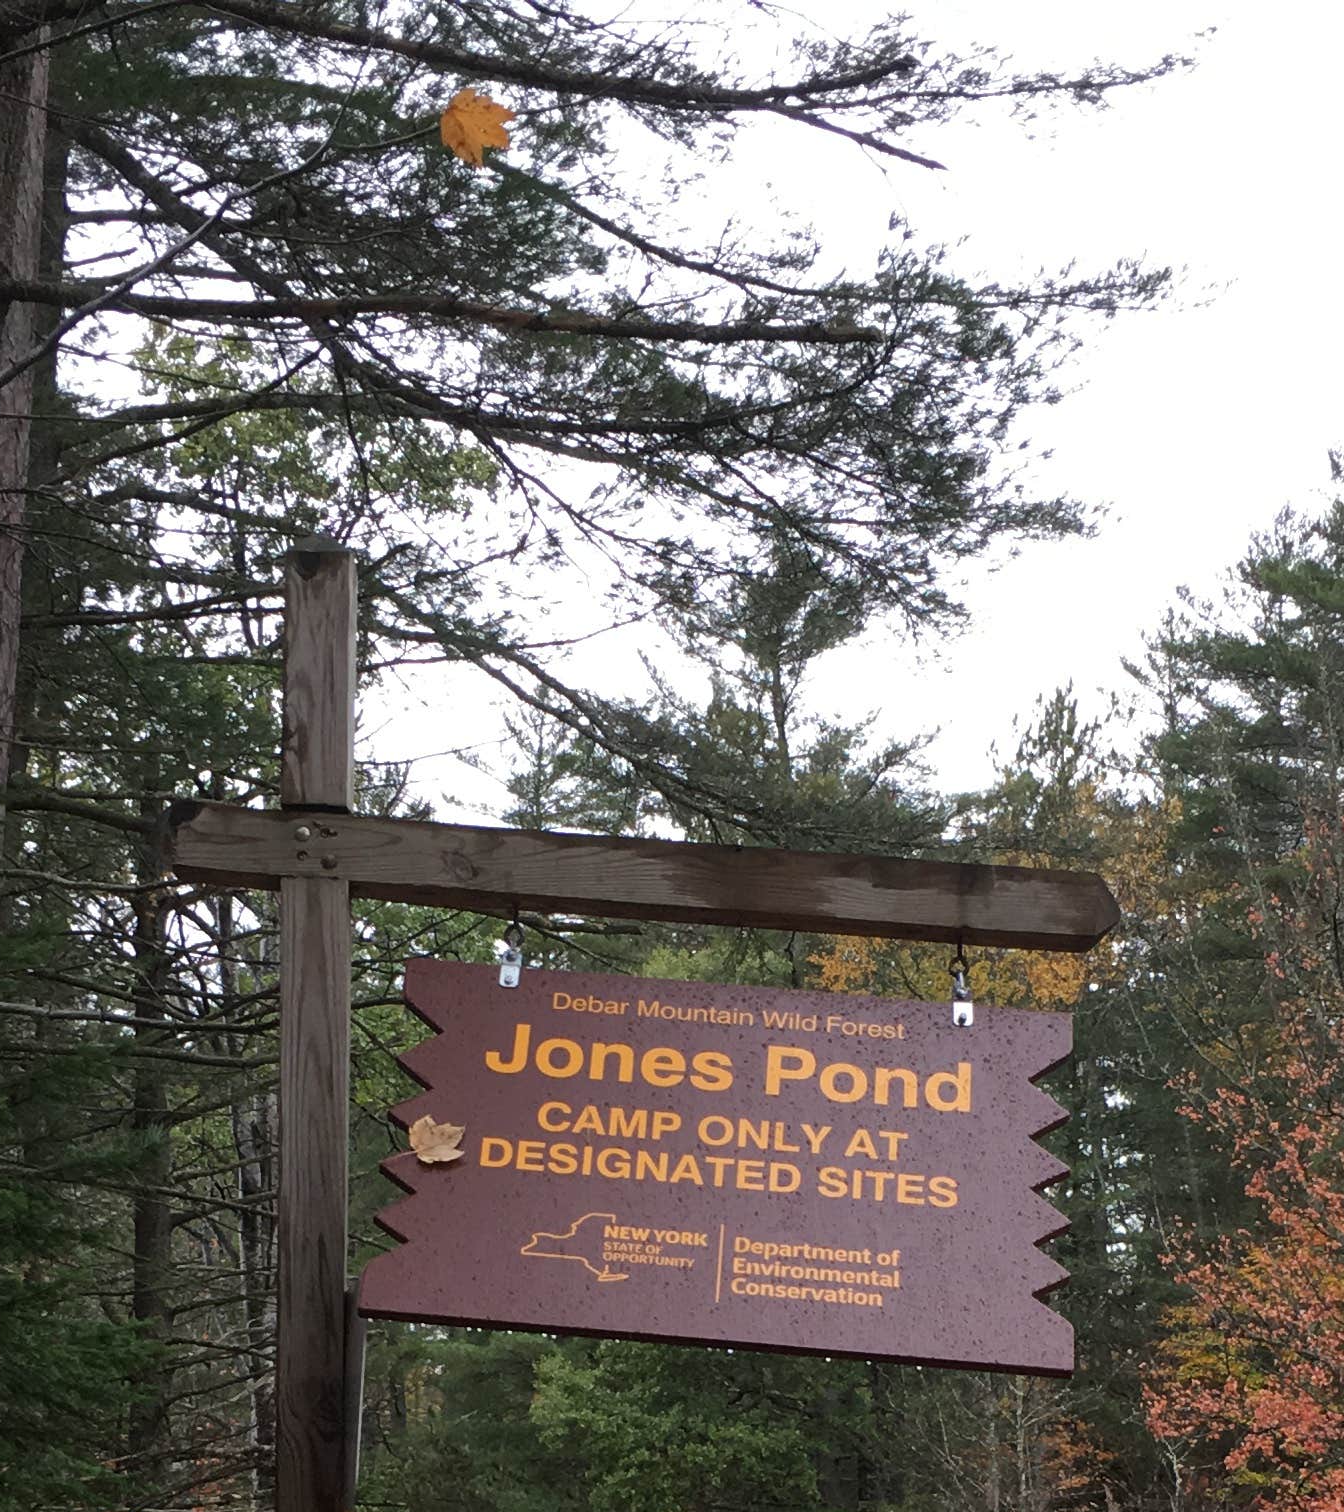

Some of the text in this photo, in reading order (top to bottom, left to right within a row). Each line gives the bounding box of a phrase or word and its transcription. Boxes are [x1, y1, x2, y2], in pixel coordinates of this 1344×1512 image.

[552, 992, 906, 1040] Debar Mountain Wild Forest
[485, 1023, 972, 1112] Jones Pond
[537, 1101, 909, 1162] CAMP ONLY AT
[480, 1138, 959, 1209] DESIGNATED SITES
[604, 1225, 708, 1247] NEW YORK
[604, 1241, 663, 1254] STATE OF
[603, 1252, 695, 1268] OPPORTUNITY
[734, 1236, 900, 1267] Department of
[733, 1258, 900, 1288] Environmental
[731, 1277, 883, 1307] Conservation
